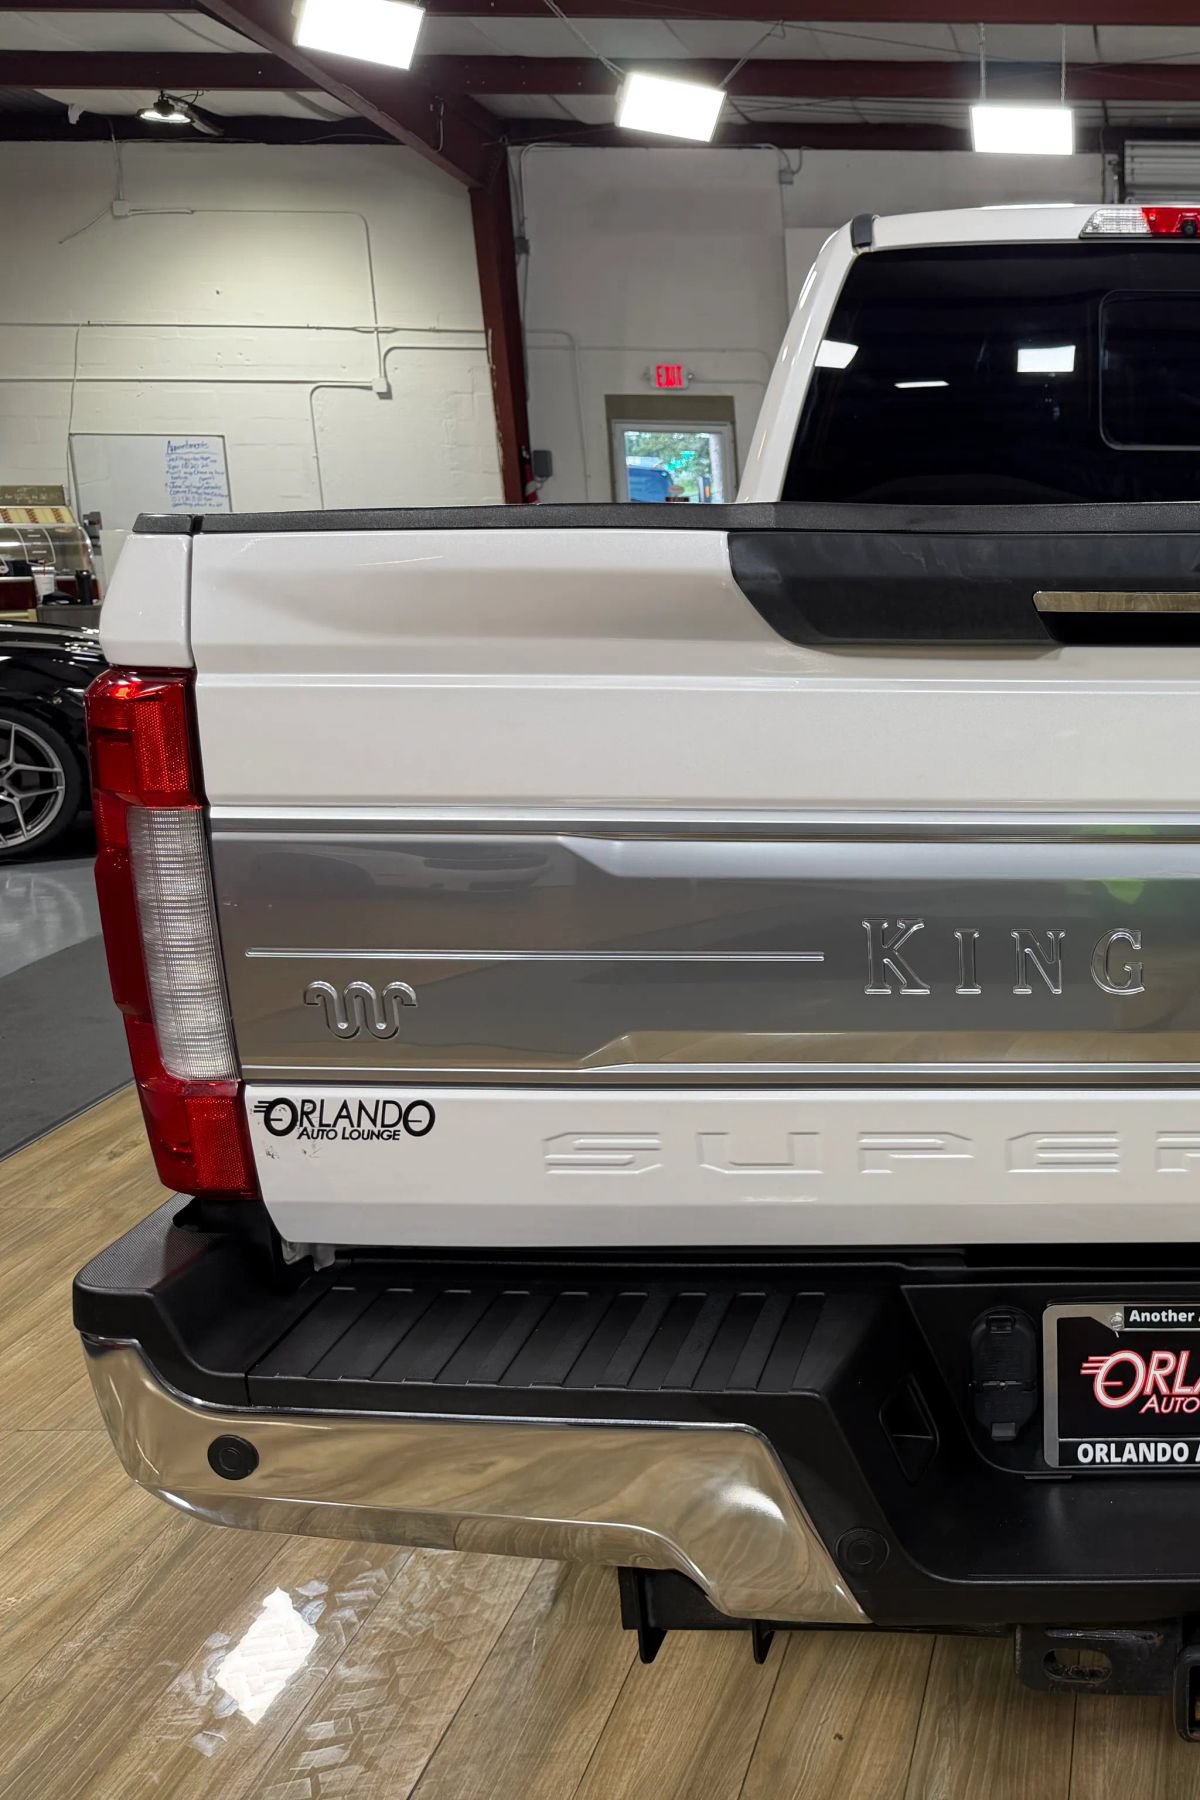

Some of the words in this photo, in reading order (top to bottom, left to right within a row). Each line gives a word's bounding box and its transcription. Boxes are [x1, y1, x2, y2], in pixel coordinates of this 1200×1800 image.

[656, 365, 683, 388] EXIT
[863, 918, 1145, 996] KING
[254, 1097, 436, 1137] ORLANDO
[297, 1127, 338, 1141] AUTO
[341, 1127, 401, 1141] LOUNGE
[1129, 1309, 1196, 1323] Another
[1139, 1394, 1200, 1414] AUTO
[1077, 1442, 1190, 1464] ORLANDO
